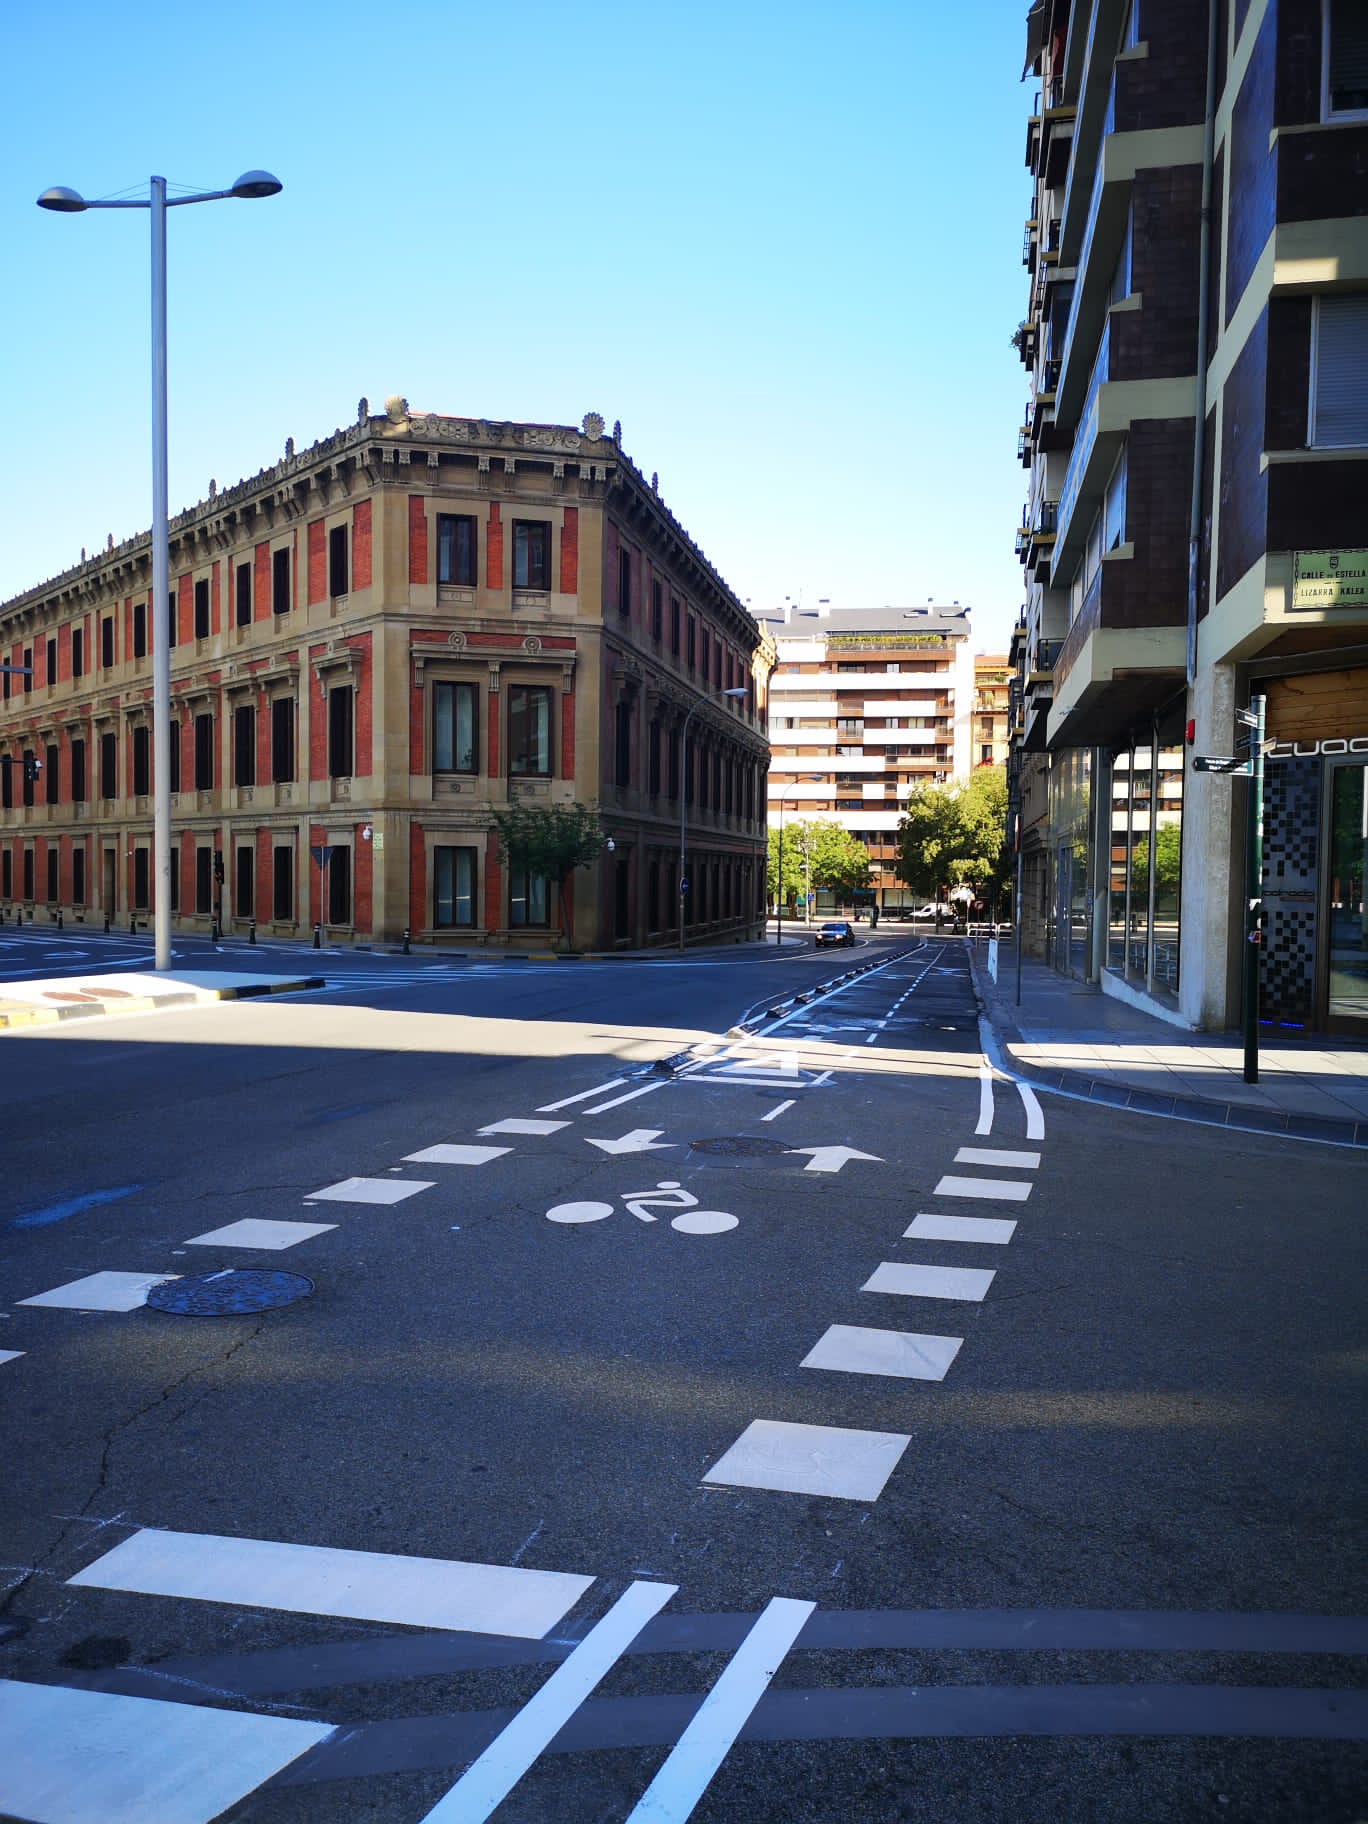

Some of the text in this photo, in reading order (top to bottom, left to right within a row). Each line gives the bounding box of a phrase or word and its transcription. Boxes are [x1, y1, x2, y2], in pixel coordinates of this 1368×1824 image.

[1335, 570, 1366, 578] ESTELLA
[1301, 587, 1365, 597] LIZARRA KALEA
